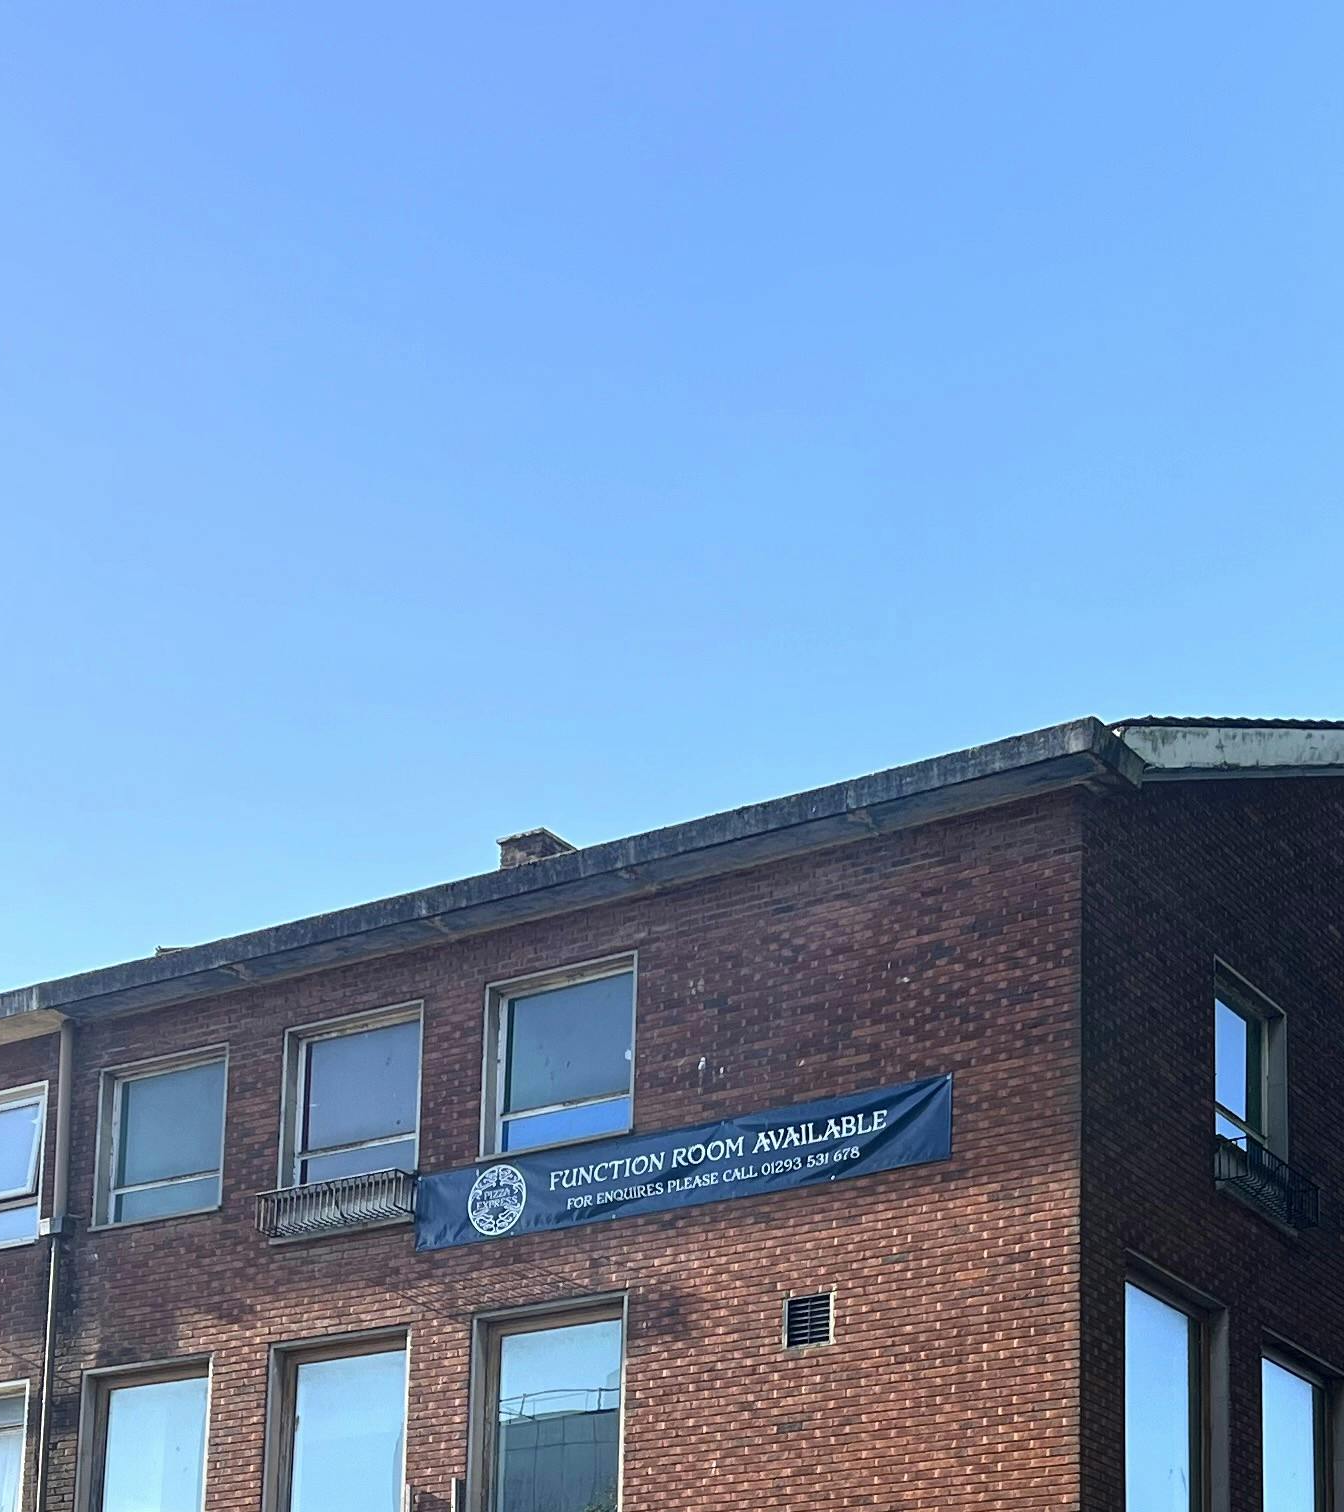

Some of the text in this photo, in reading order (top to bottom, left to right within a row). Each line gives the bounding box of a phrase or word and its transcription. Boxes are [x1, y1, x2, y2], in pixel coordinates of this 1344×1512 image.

[549, 1109, 888, 1191] FUNCTION ROOM AVAILABLE
[483, 1188, 511, 1202] PIZZA
[566, 1146, 860, 1210] FOR ENQUIRES PLEASE CALL 01293 531 678
[476, 1196, 518, 1211] EXPRESS
